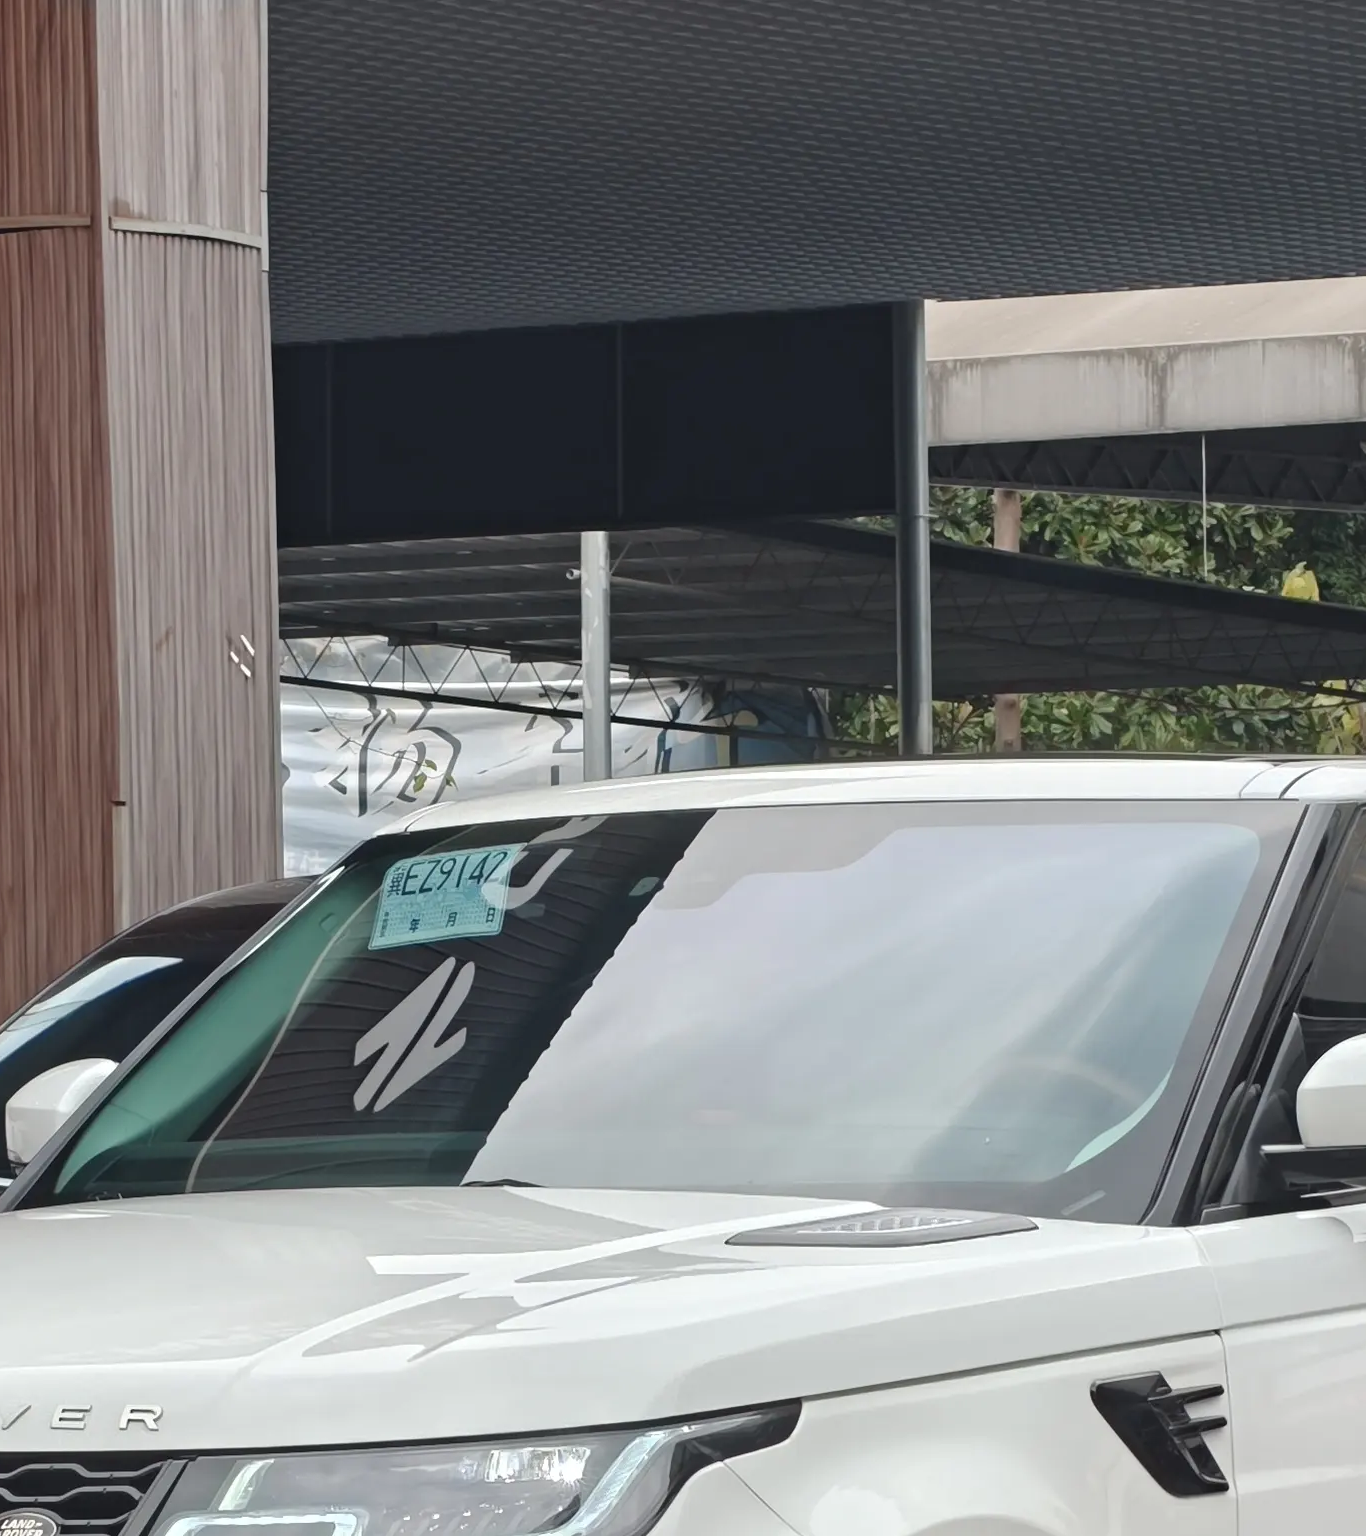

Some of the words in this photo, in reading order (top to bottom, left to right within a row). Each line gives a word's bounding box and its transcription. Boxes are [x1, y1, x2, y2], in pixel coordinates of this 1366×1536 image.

[446, 911, 458, 928] 月
[485, 906, 496, 924] 日
[0, 1519, 36, 1530] LAND
